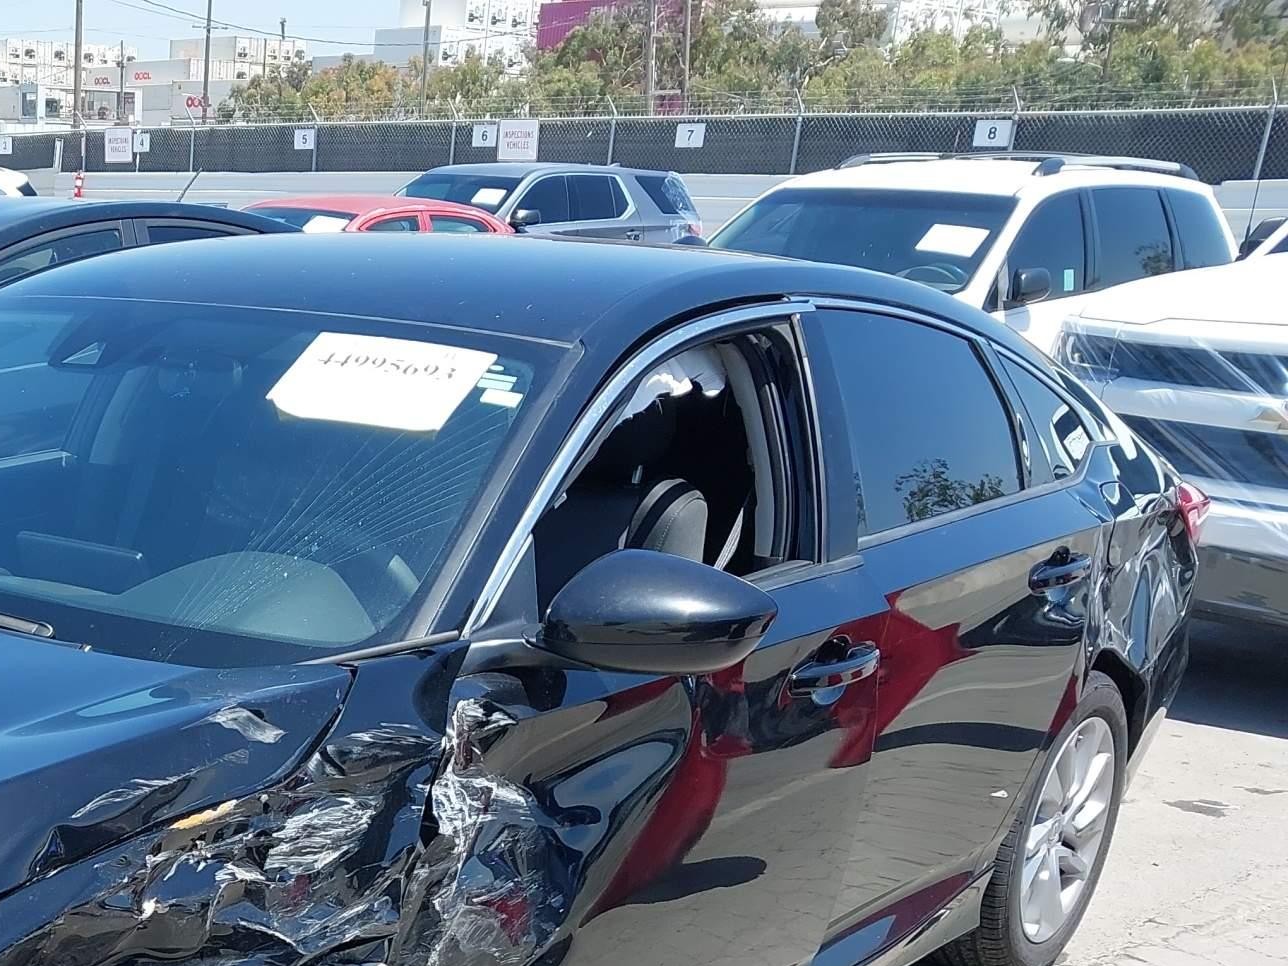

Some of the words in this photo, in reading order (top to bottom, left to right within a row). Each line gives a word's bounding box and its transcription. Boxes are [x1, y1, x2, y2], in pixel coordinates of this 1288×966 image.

[94, 77, 111, 85] OOCL
[134, 72, 152, 81] OOCL
[481, 130, 488, 142] 6
[687, 129, 695, 141] 7
[988, 126, 998, 140] 8
[139, 137, 145, 148] 4
[301, 134, 308, 145] 5
